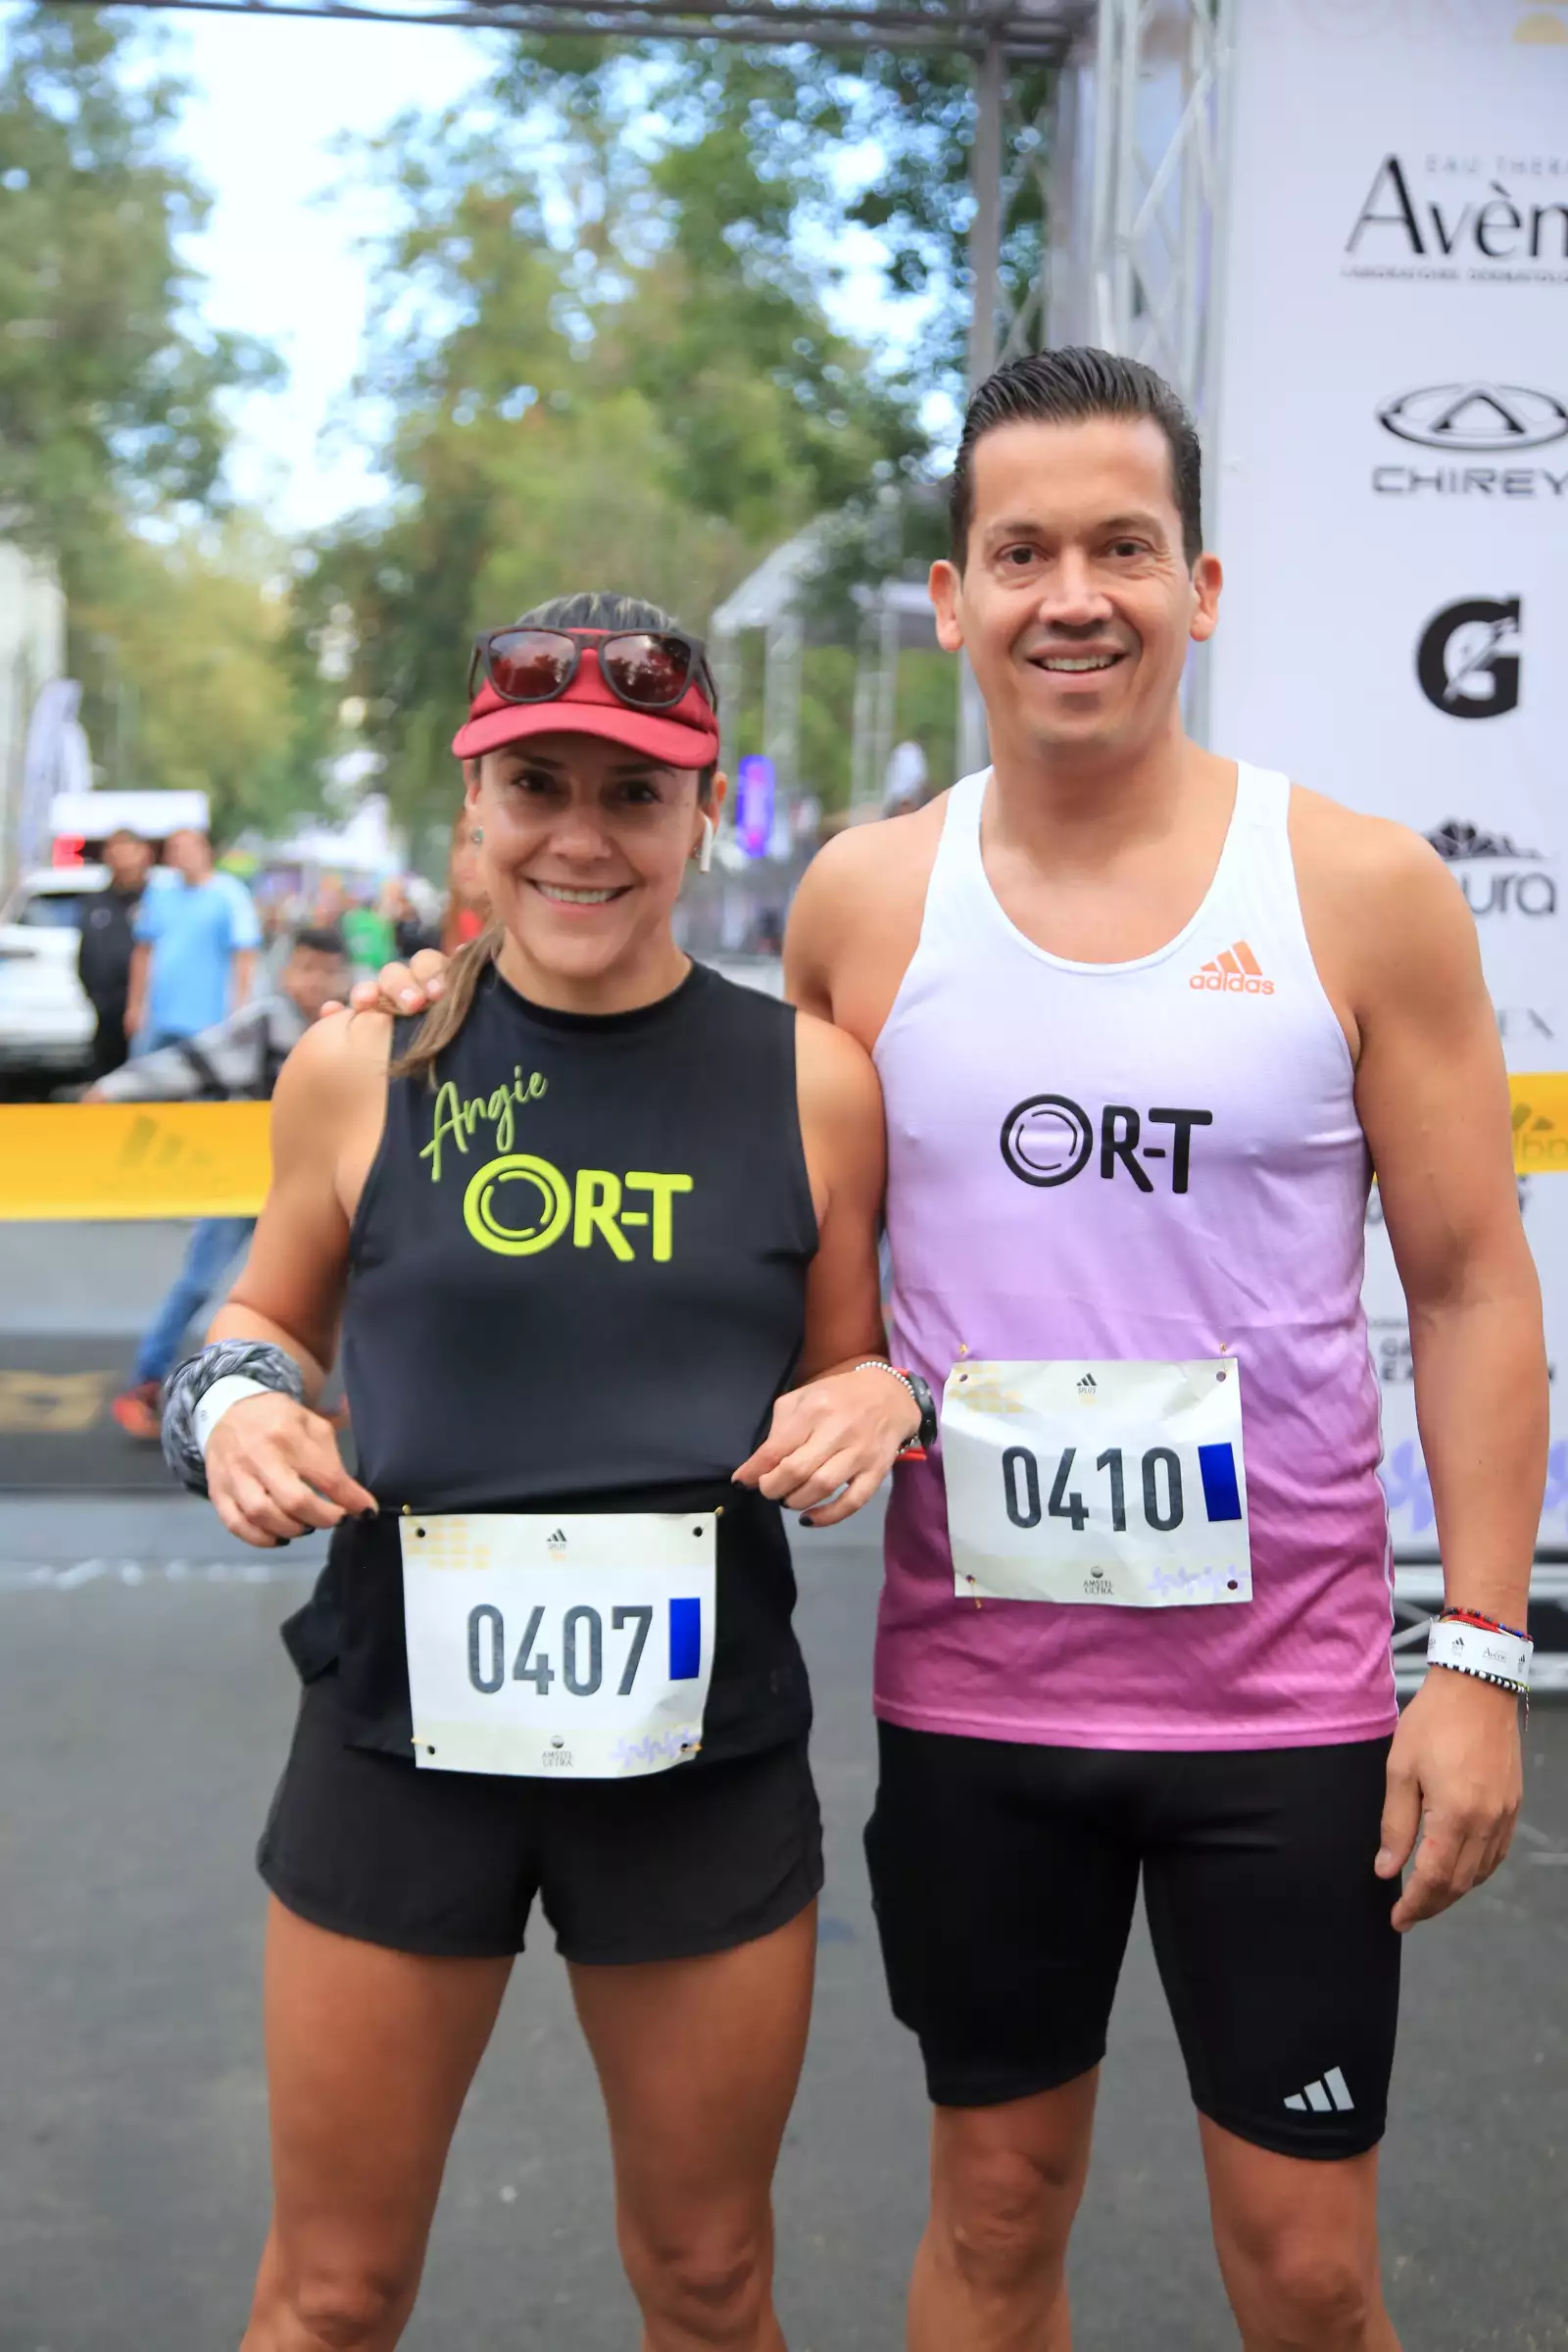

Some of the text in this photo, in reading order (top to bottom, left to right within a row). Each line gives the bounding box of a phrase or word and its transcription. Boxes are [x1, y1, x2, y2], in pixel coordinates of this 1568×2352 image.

[1494, 155, 1568, 176] THER
[1372, 466, 1568, 497] CHIREY
[1190, 971, 1274, 995] adidas
[419, 1064, 547, 1183] Angie
[1000, 1093, 1213, 1195] OR-T
[463, 1153, 694, 1262] OR-T
[1002, 1445, 1184, 1532] 0410
[466, 1603, 654, 1697] 0407
